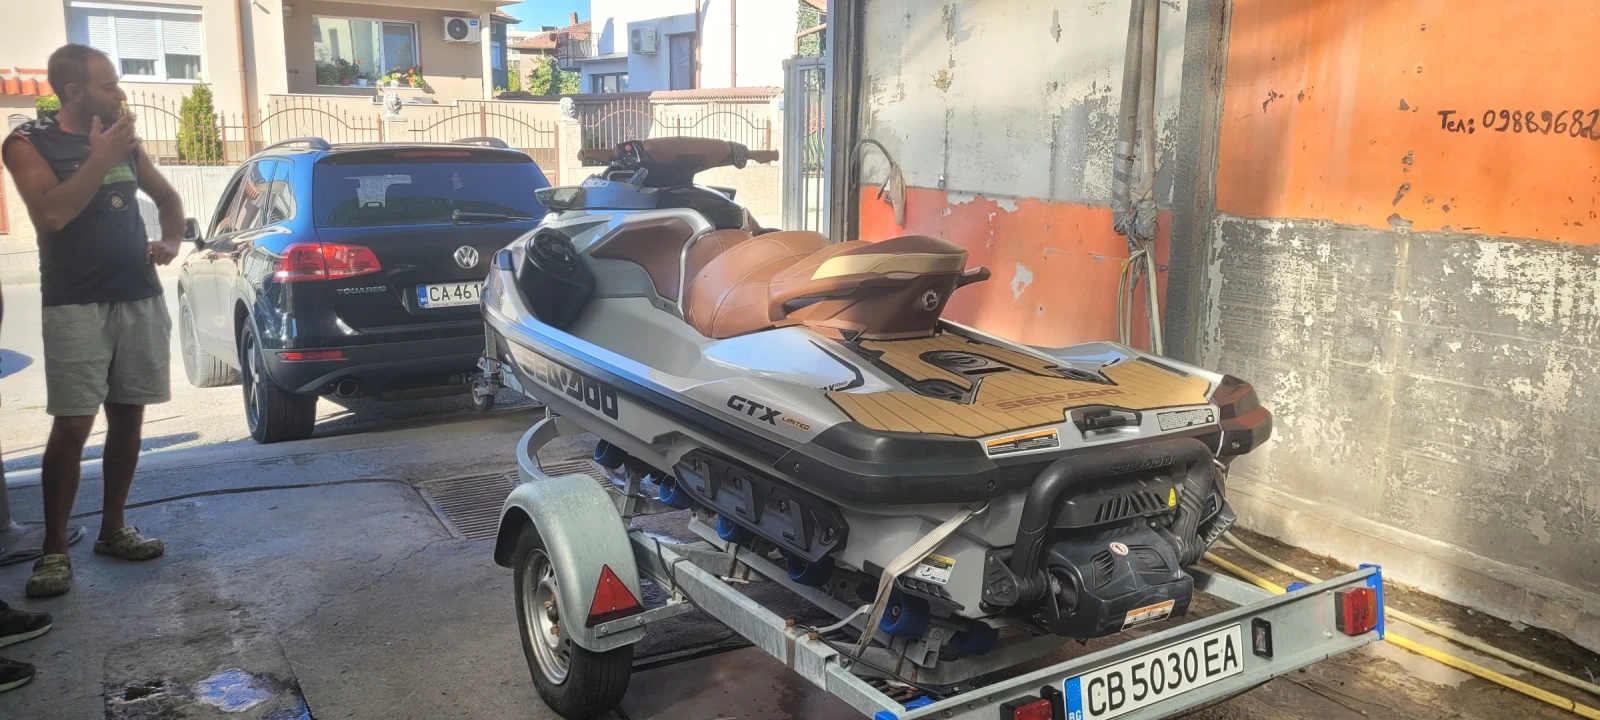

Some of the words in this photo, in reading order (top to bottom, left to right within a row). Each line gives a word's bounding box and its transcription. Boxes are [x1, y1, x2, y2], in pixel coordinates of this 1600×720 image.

[1438, 110, 1475, 134] Тел:
[584, 178, 610, 188] 300
[336, 285, 387, 295] TOUAREG
[429, 286, 450, 301] CA
[454, 283, 483, 299] 461
[726, 394, 783, 426] GTX
[781, 416, 810, 430] LIMITED
[1087, 670, 1126, 717] CB
[1131, 646, 1199, 701] 5030
[1203, 633, 1238, 678] EA
